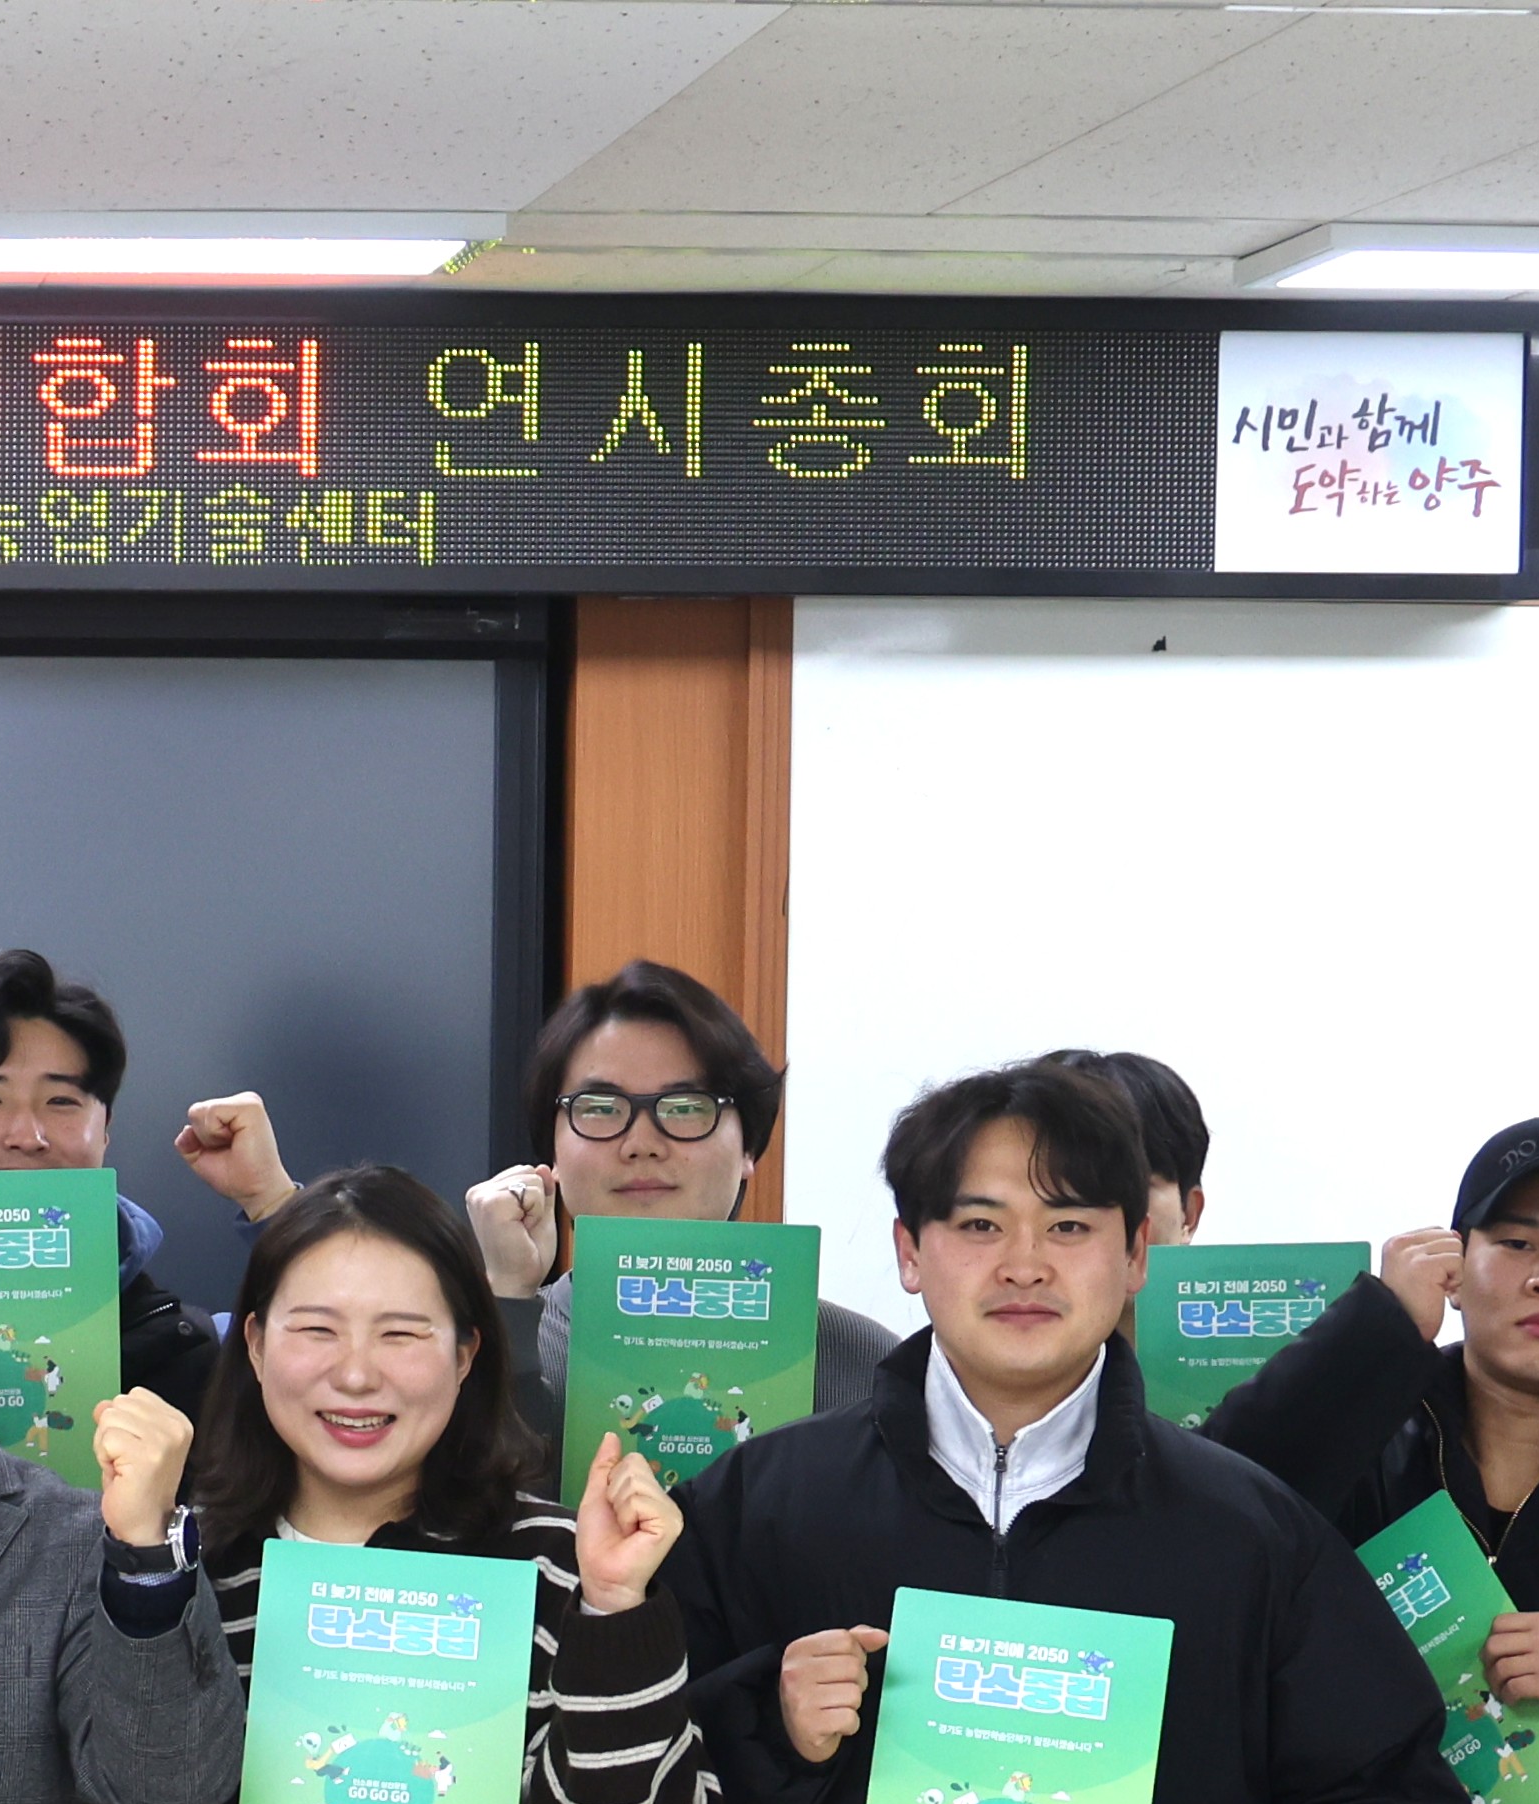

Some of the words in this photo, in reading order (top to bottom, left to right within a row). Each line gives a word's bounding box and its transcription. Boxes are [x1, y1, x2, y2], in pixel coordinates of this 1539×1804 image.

[426, 341, 1028, 479] 연시총회
[1232, 397, 1348, 452] 시민과
[1352, 393, 1441, 453] 함께
[1288, 459, 1401, 517] 도약하는
[1408, 456, 1502, 518] 양주
[617, 1254, 632, 1269] 더
[635, 1255, 663, 1270] 늦기
[665, 1256, 693, 1271] 전에
[695, 1257, 733, 1273] 2050
[615, 1275, 771, 1320] 탄소중립
[1177, 1281, 1191, 1295] 더
[1223, 1279, 1249, 1294] 전에
[1251, 1279, 1287, 1293] 2050
[622, 1335, 645, 1345] 경기도
[6, 1394, 24, 1407] GO
[657, 1440, 675, 1453] GO
[676, 1441, 694, 1454] GO
[694, 1442, 713, 1455] GO
[1375, 1571, 1395, 1591] 50
[311, 1581, 327, 1597] 더
[330, 1583, 361, 1600] 늦기
[364, 1586, 395, 1603] 전에
[397, 1589, 438, 1607] 2050
[307, 1603, 480, 1660] 탄소중립
[939, 1633, 956, 1650] 더
[959, 1635, 990, 1654] 늦기
[993, 1640, 1024, 1658] 전에
[1026, 1644, 1069, 1663] 2050
[934, 1656, 1110, 1720] 탄소중립
[938, 1723, 963, 1736] 경기도
[347, 1785, 368, 1799] GO
[368, 1787, 389, 1801] GO
[389, 1789, 410, 1803] GO
